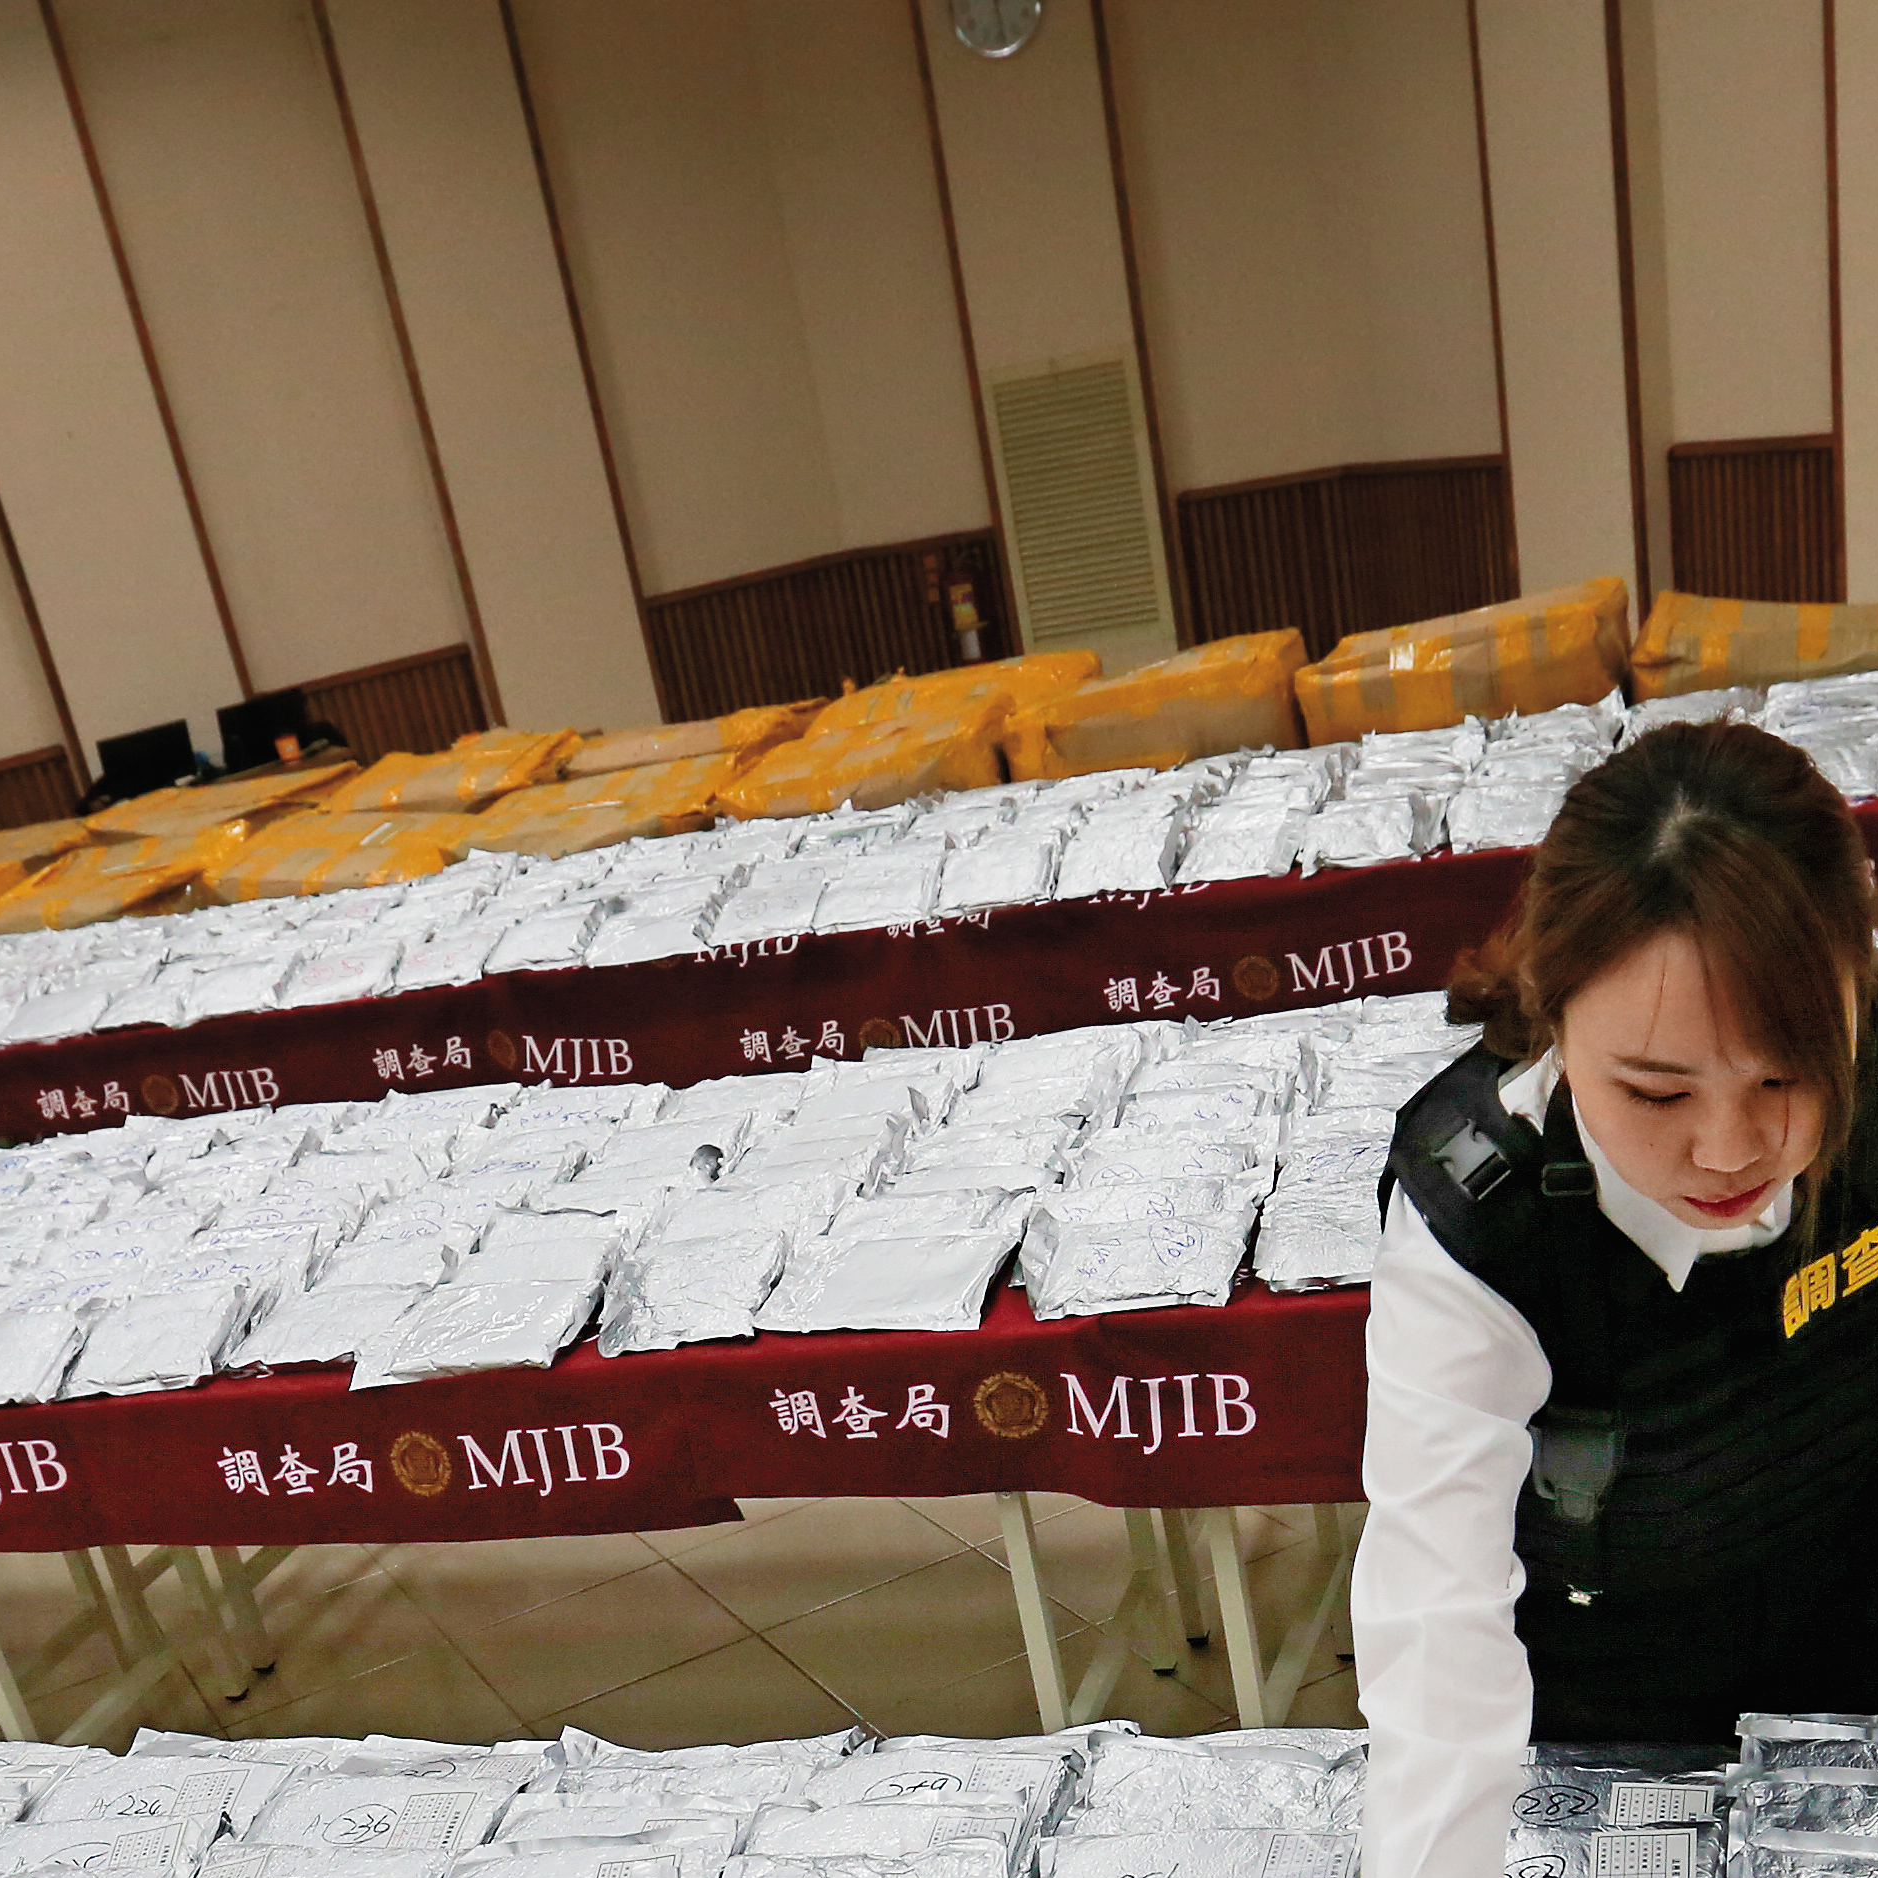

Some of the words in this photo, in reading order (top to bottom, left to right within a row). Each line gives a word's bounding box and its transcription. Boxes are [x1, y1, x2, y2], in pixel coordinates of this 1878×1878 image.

[1286, 931, 1414, 993] MJIB
[1104, 969, 1220, 1012] 調查局
[741, 1019, 844, 1062] 調查局
[899, 1003, 1016, 1052] MJIB
[373, 1040, 471, 1082] 調查局
[523, 1035, 634, 1080] MJIB
[37, 1081, 130, 1122] 調查局
[179, 1068, 279, 1111] MJIB
[768, 1383, 950, 1440] 調查局
[1060, 1373, 1256, 1454] MJIB
[217, 1441, 374, 1497] 調查局
[456, 1424, 631, 1497] MJIB
[343, 1812, 390, 1836] 236
[1521, 1793, 1590, 1816] 282
